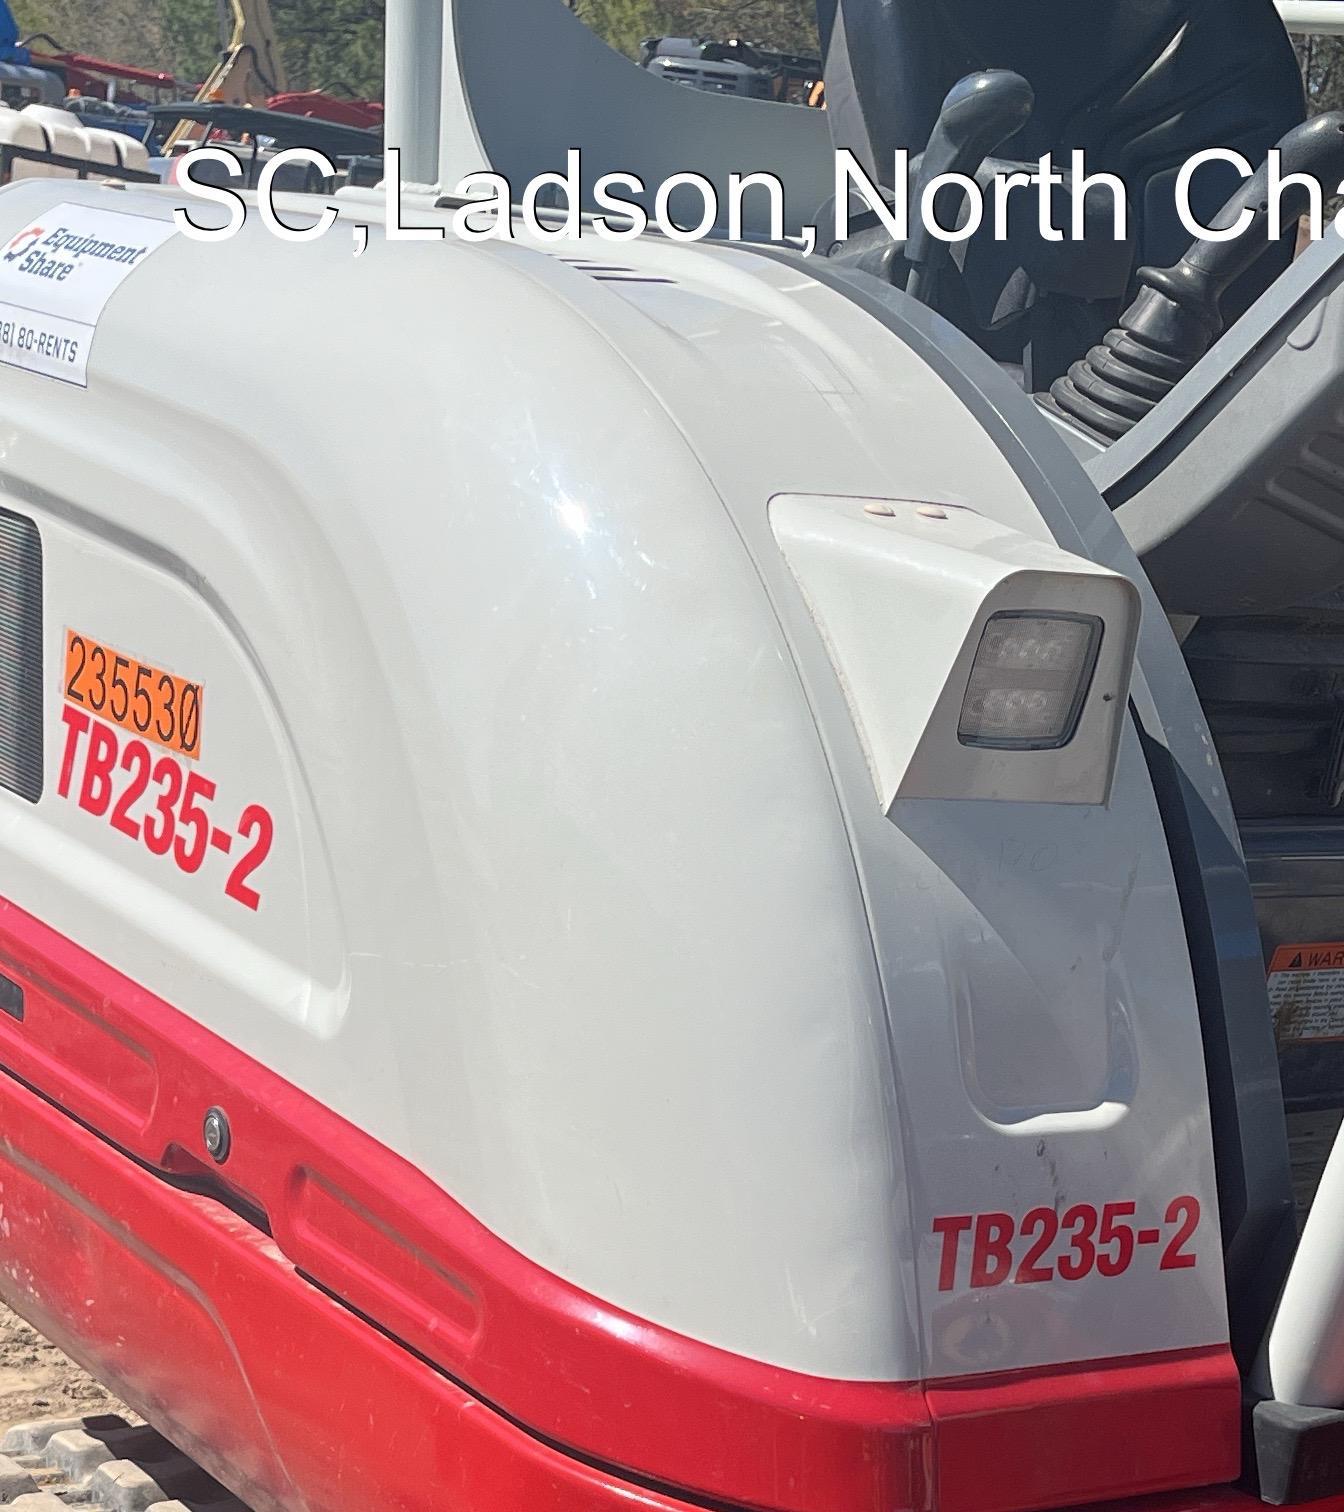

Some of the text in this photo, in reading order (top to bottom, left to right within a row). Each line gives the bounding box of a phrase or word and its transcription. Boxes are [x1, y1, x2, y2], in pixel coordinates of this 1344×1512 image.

[18, 250, 75, 282] Share
[42, 227, 147, 265] Equipment
[17, 329, 79, 364] 80-RENTS
[66, 634, 202, 753] 235530
[57, 703, 274, 911] TB235-2
[932, 1195, 1201, 1291] TB235-2
